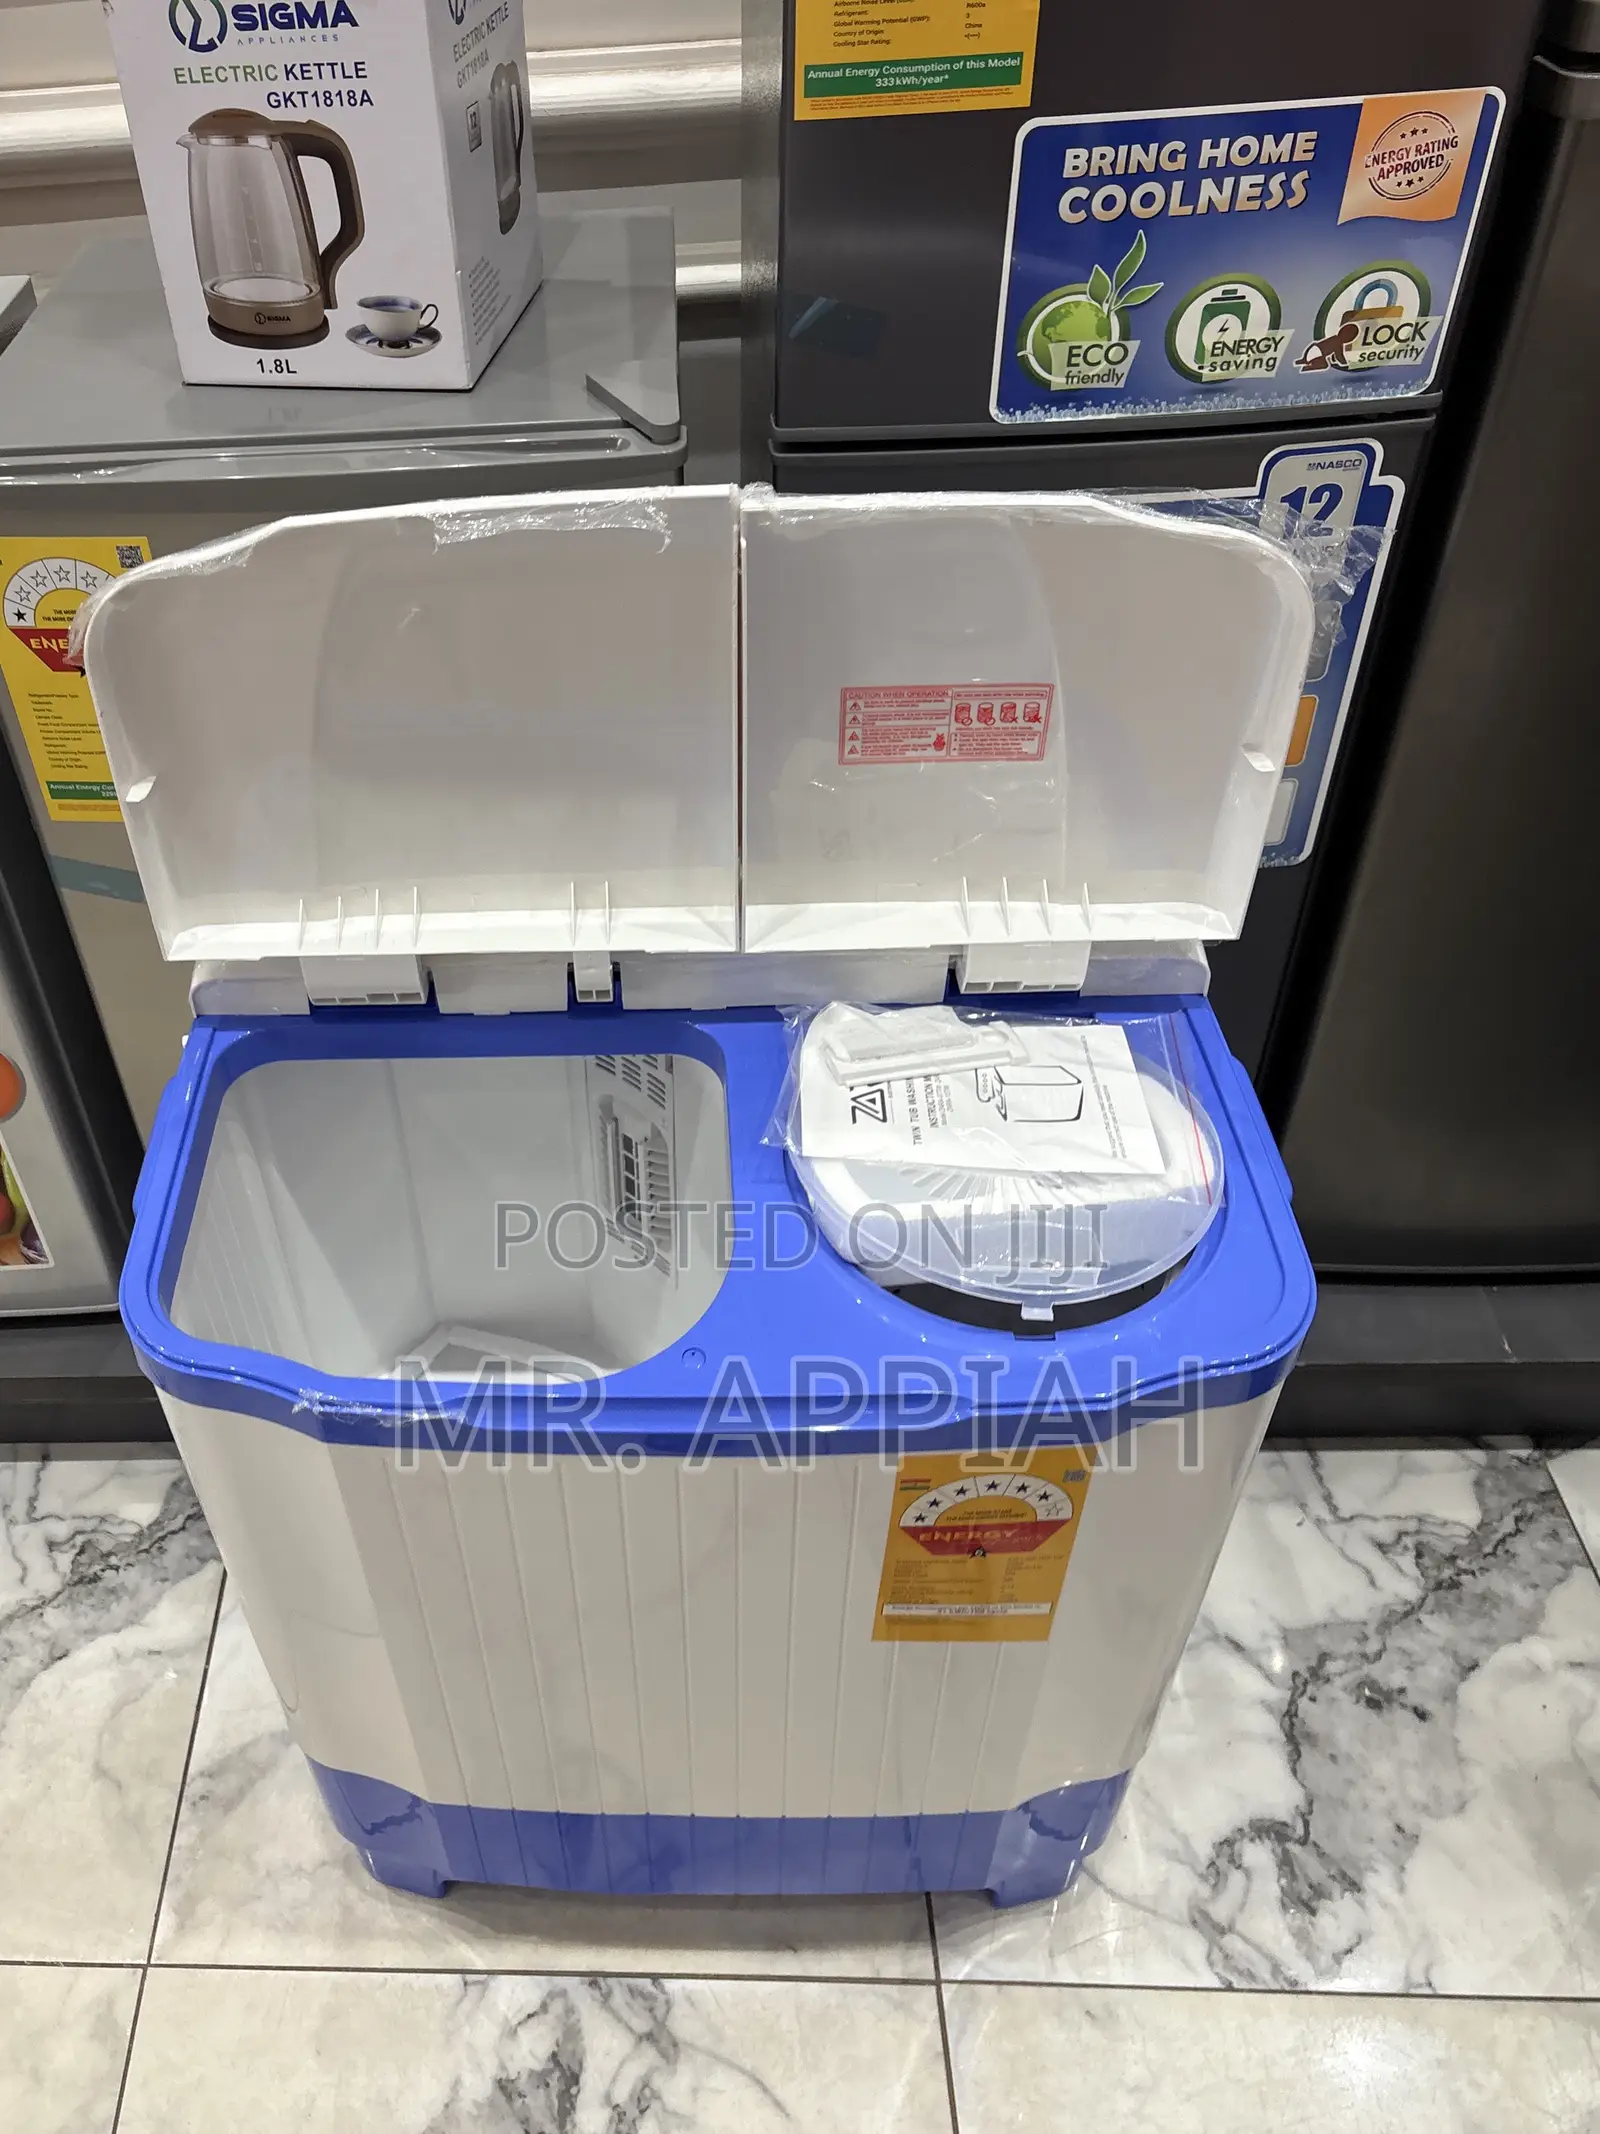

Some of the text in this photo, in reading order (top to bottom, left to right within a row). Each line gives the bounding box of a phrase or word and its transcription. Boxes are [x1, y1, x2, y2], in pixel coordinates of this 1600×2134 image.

[231, 0, 360, 31] SIGMA
[237, 34, 339, 46] APPLIANCES
[453, 1, 509, 63] ELECTRIC KETTLE
[173, 61, 368, 84] ELECTRIC KETTLE
[808, 56, 1020, 79] Annual Energy Consumption of this Model
[875, 77, 895, 88] 333
[266, 89, 374, 109] GKT1818A
[1063, 131, 1318, 178] BRING HOME
[1365, 136, 1459, 168] ENERGY RATING
[1377, 154, 1445, 181] APPROVED
[1058, 170, 1310, 224] COOLNESS
[1362, 321, 1430, 346] LOCK
[1066, 342, 1129, 368] ECO
[1211, 336, 1285, 358] ENERGY
[1358, 344, 1424, 362] security
[257, 358, 297, 374] 1.8L
[1208, 353, 1277, 373] saving
[1065, 368, 1125, 386] friendly
[1315, 458, 1362, 470] NASCO
[1280, 482, 1343, 538] 12
[29, 635, 69, 653] ENE
[76, 783, 100, 791] Energy
[924, 1083, 940, 1128] INSTRUCTION
[919, 1528, 1018, 1543] ENERGY
